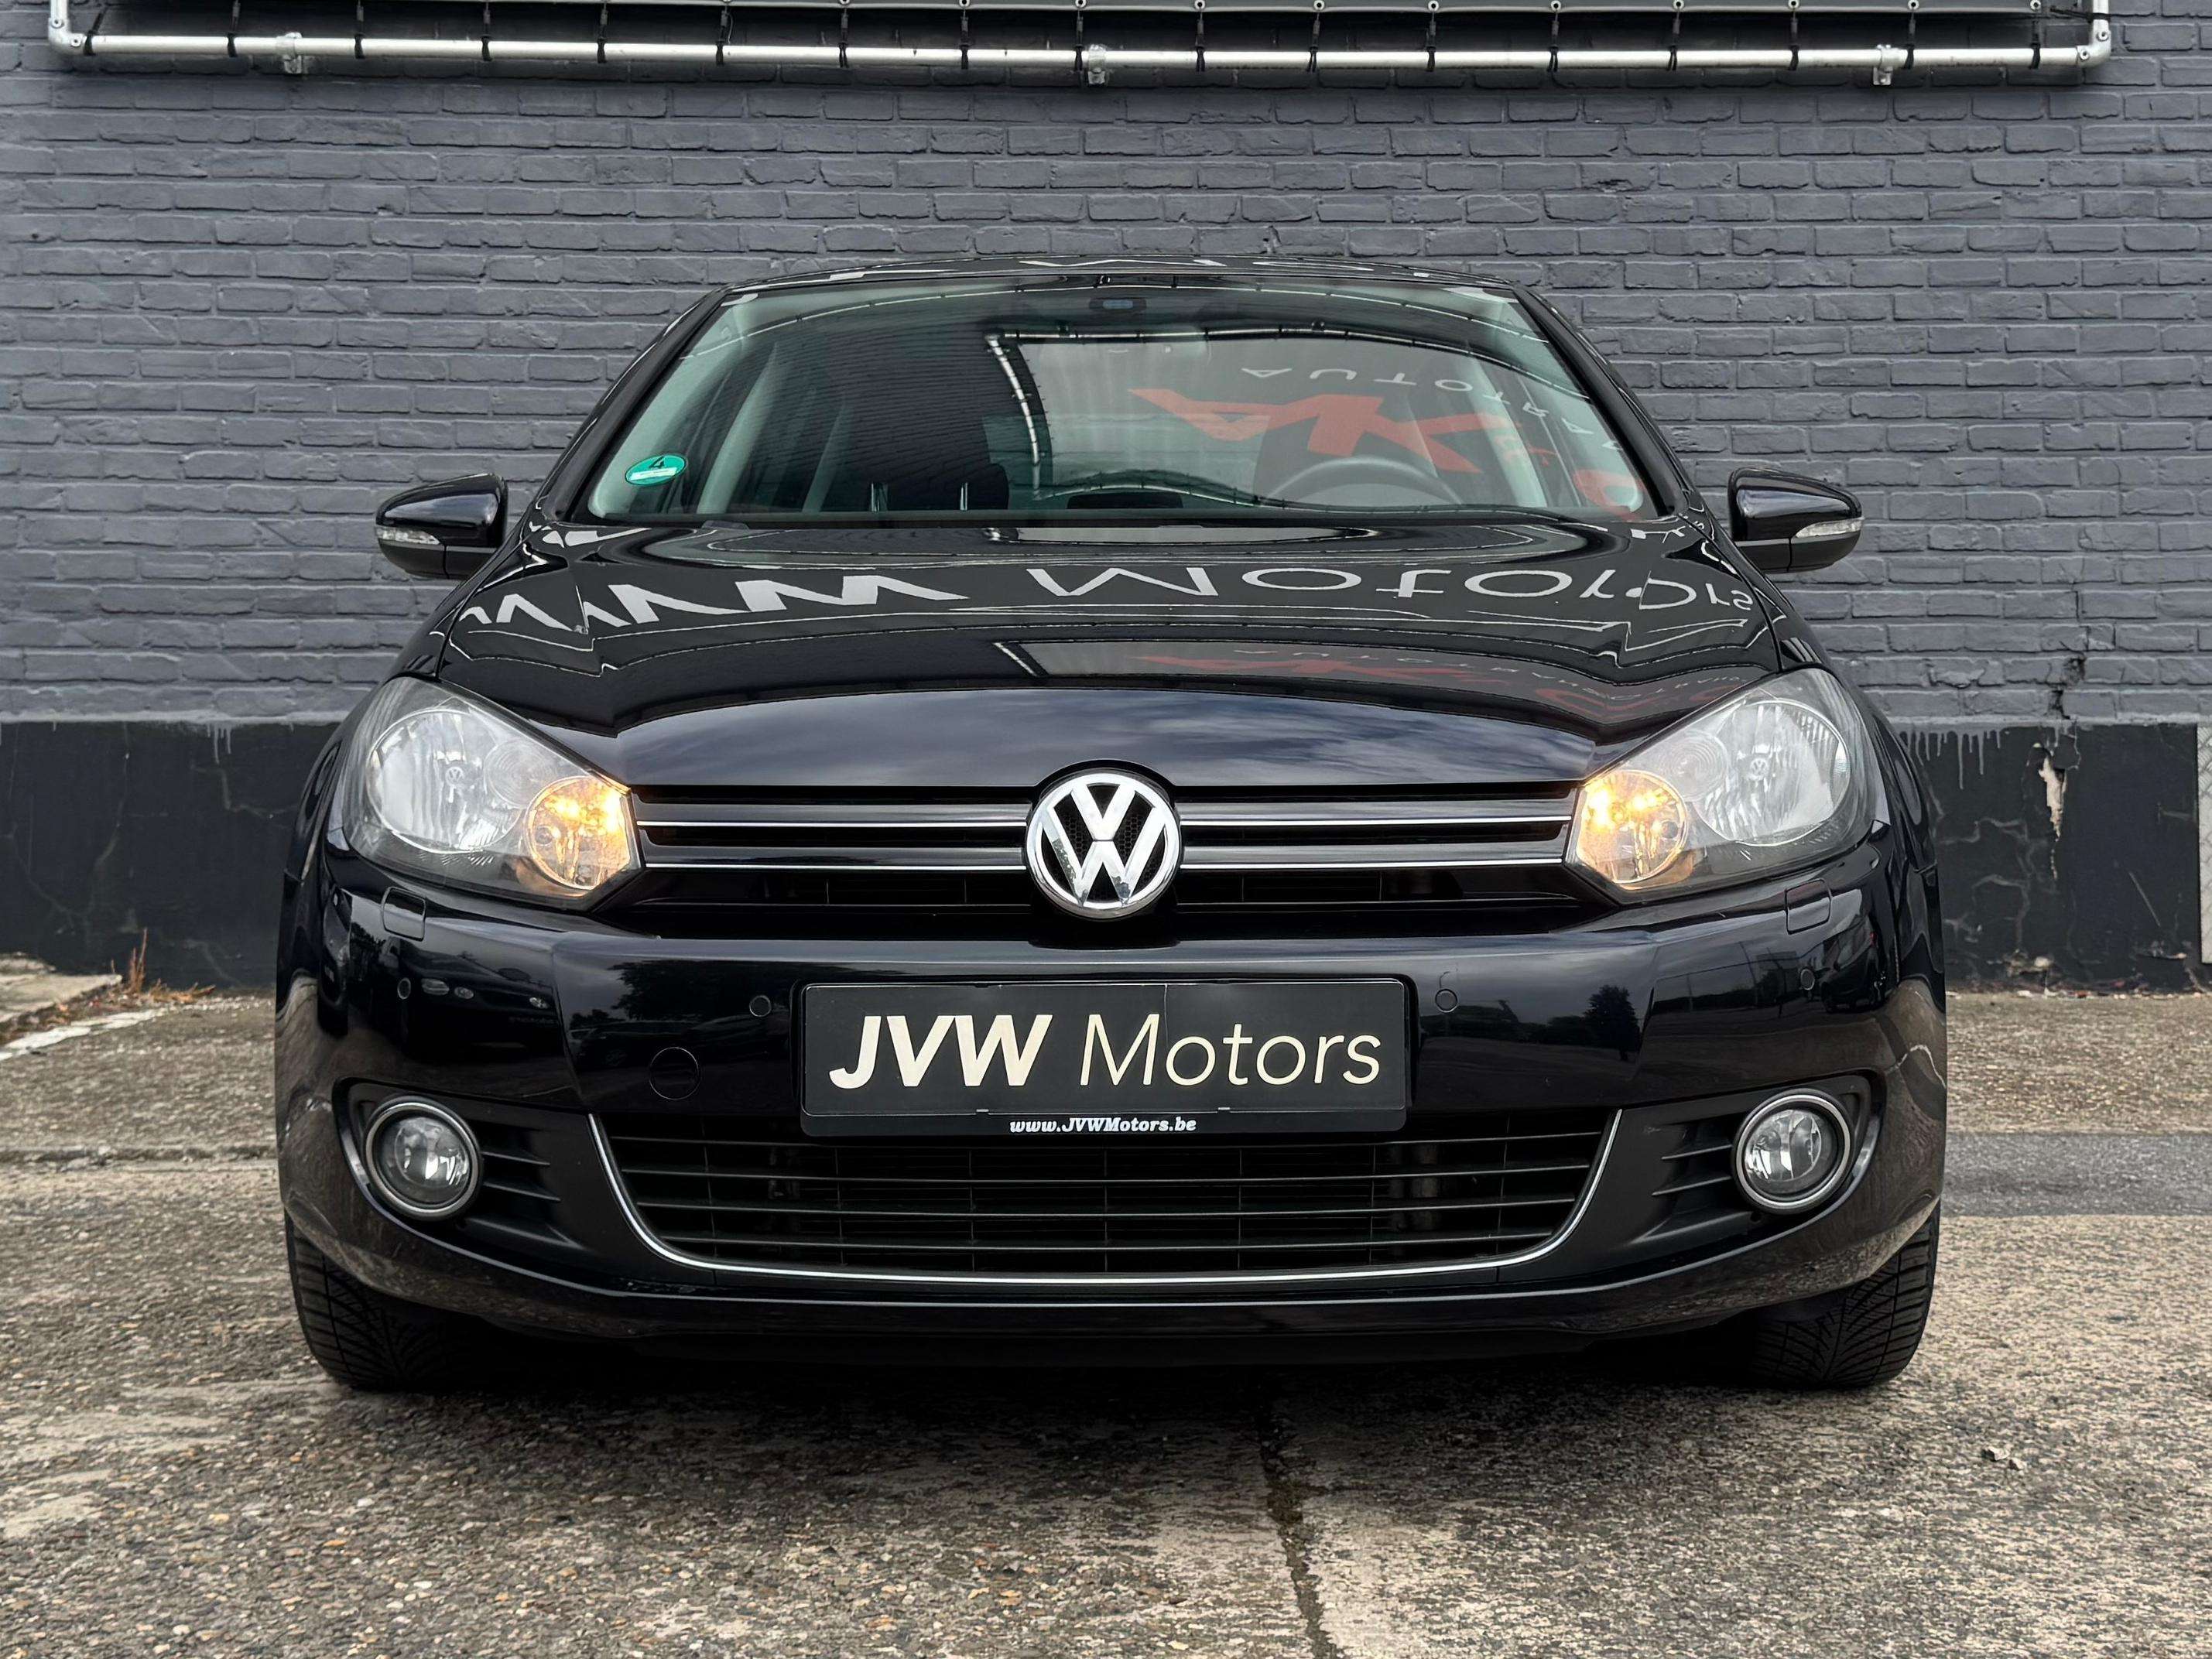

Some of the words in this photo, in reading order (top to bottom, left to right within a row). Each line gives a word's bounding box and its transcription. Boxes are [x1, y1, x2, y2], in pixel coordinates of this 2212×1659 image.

[1029, 771, 1177, 912] VW
[828, 1014, 1053, 1089] JVW
[1079, 1013, 1382, 1086] Motors
[1009, 1116, 1197, 1133] www.JVWMotors.be
